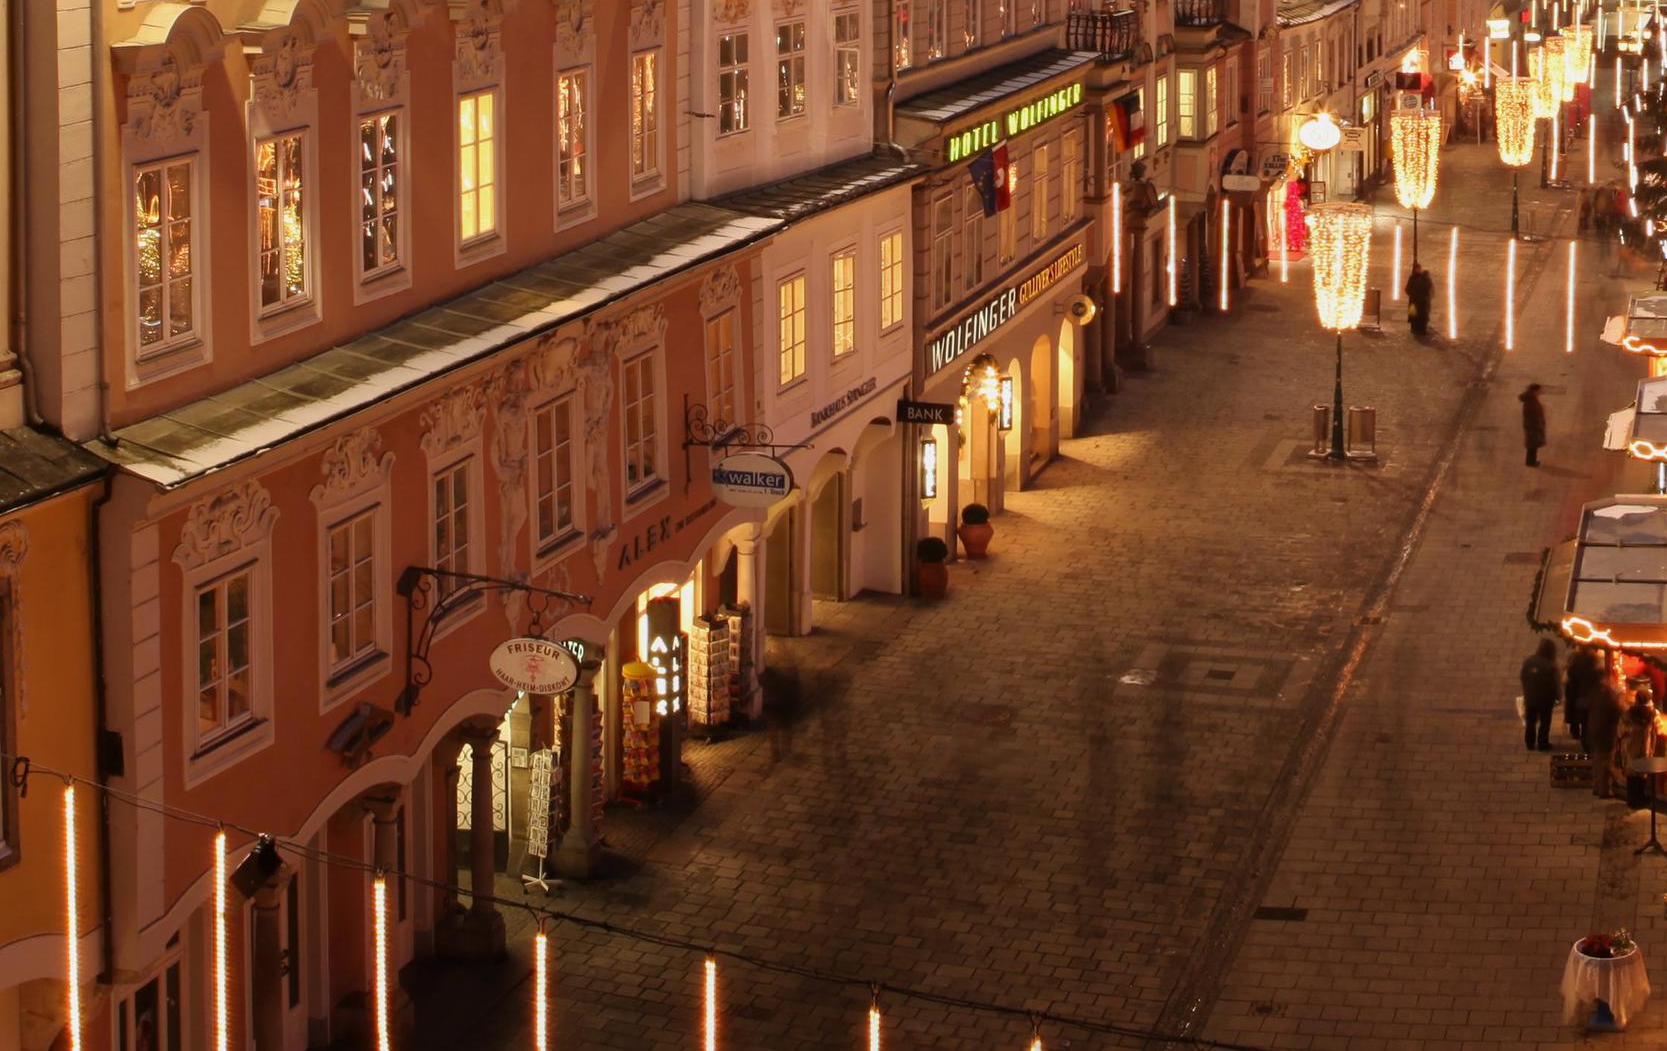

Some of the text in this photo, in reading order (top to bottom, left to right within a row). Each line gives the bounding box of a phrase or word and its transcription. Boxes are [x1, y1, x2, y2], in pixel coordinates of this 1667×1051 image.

[950, 83, 1081, 162] HOTEL WOLFINGER
[932, 288, 1016, 373] WOLFINGER
[1054, 244, 1082, 281] LIFESTYLE
[907, 406, 944, 422] BANK
[729, 470, 782, 487] walker
[618, 515, 671, 570] ALEX
[507, 643, 561, 660] FRISEUR
[495, 668, 571, 693] HAAR-HEIM-DISKONT
